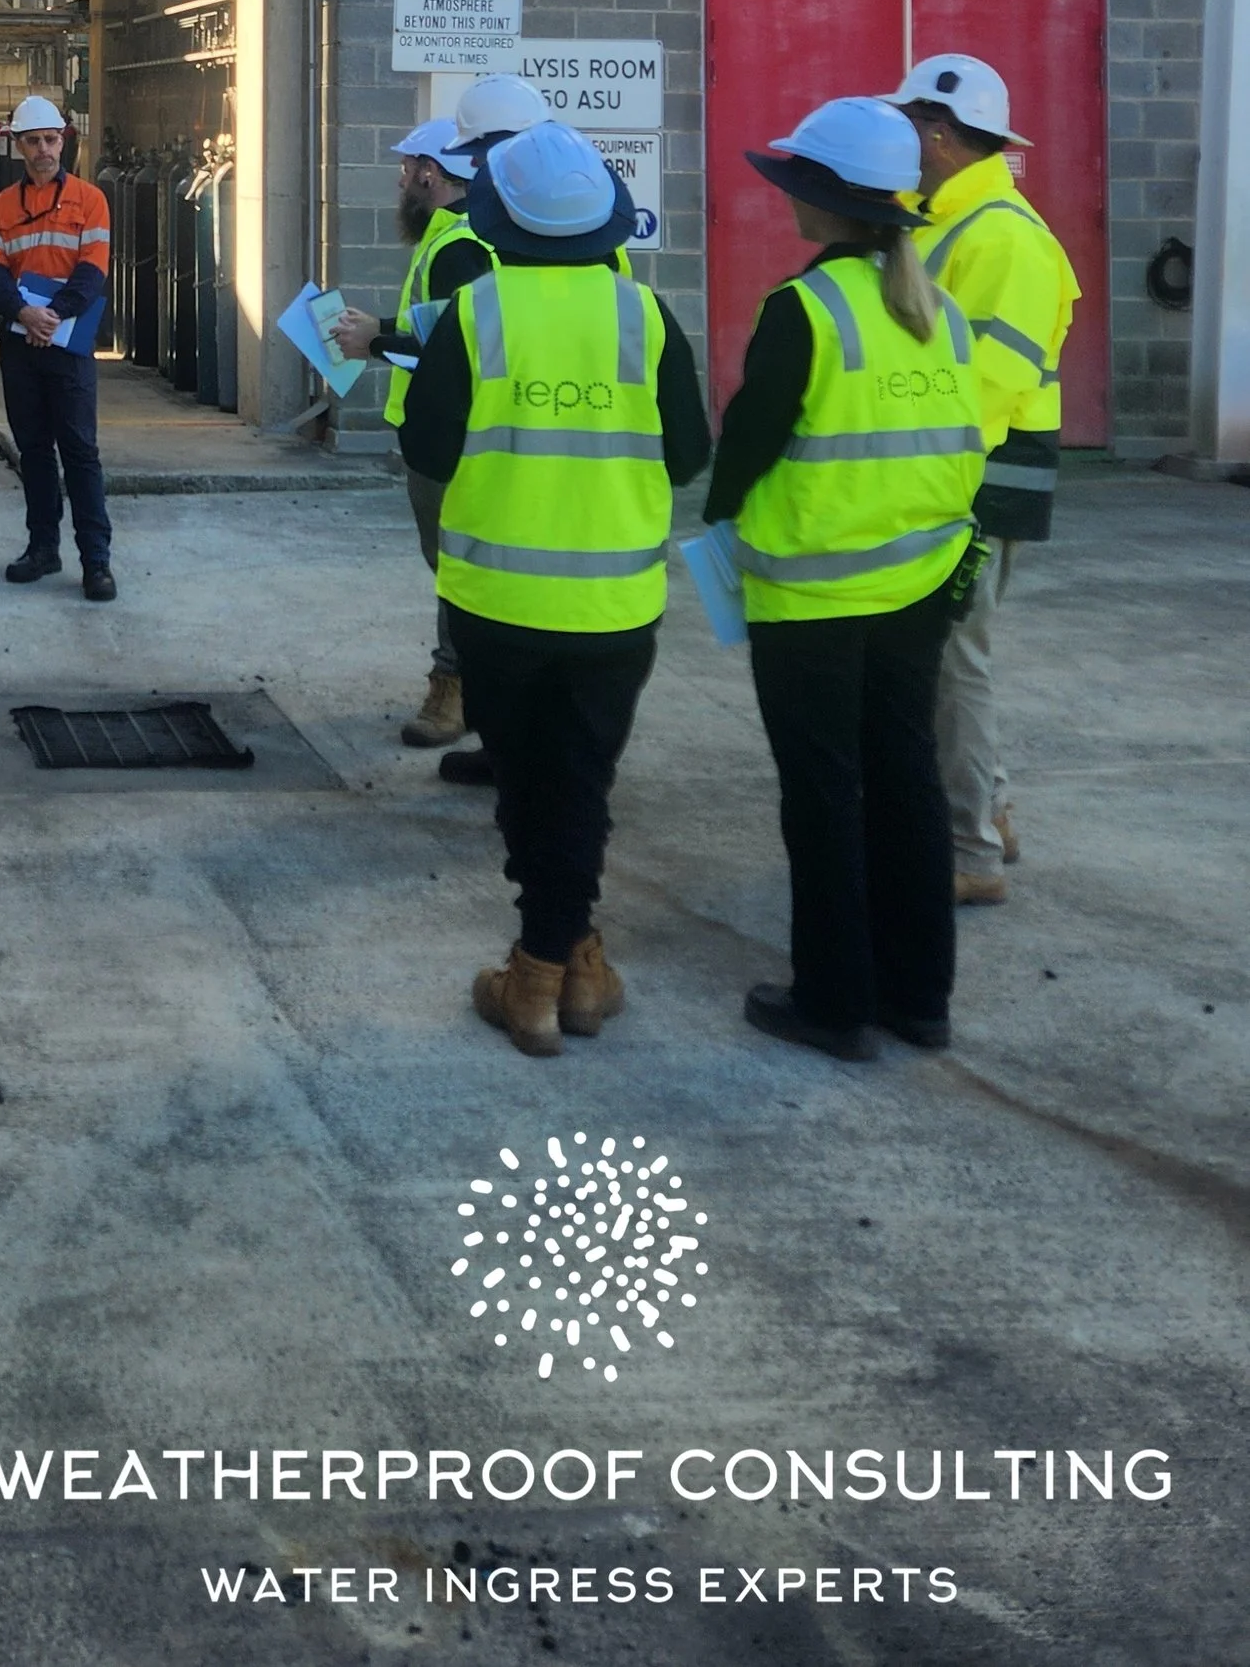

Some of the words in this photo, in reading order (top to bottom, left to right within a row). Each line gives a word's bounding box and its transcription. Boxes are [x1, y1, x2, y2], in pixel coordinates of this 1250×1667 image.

[404, 15, 447, 29] BEYOND
[452, 16, 475, 29] THIS
[480, 17, 511, 30] POINT
[415, 36, 460, 47] MONITOR
[464, 37, 514, 49] REQUIRED
[423, 53, 435, 63] AT
[438, 53, 455, 64] ALL
[459, 53, 488, 65] TIMES
[516, 58, 579, 78] LYSIS
[589, 59, 656, 80] ROOM
[540, 89, 568, 109] 50
[577, 90, 621, 110] ASU
[605, 159, 636, 178] ORN
[887, 368, 958, 407] epa
[525, 380, 612, 416] epa
